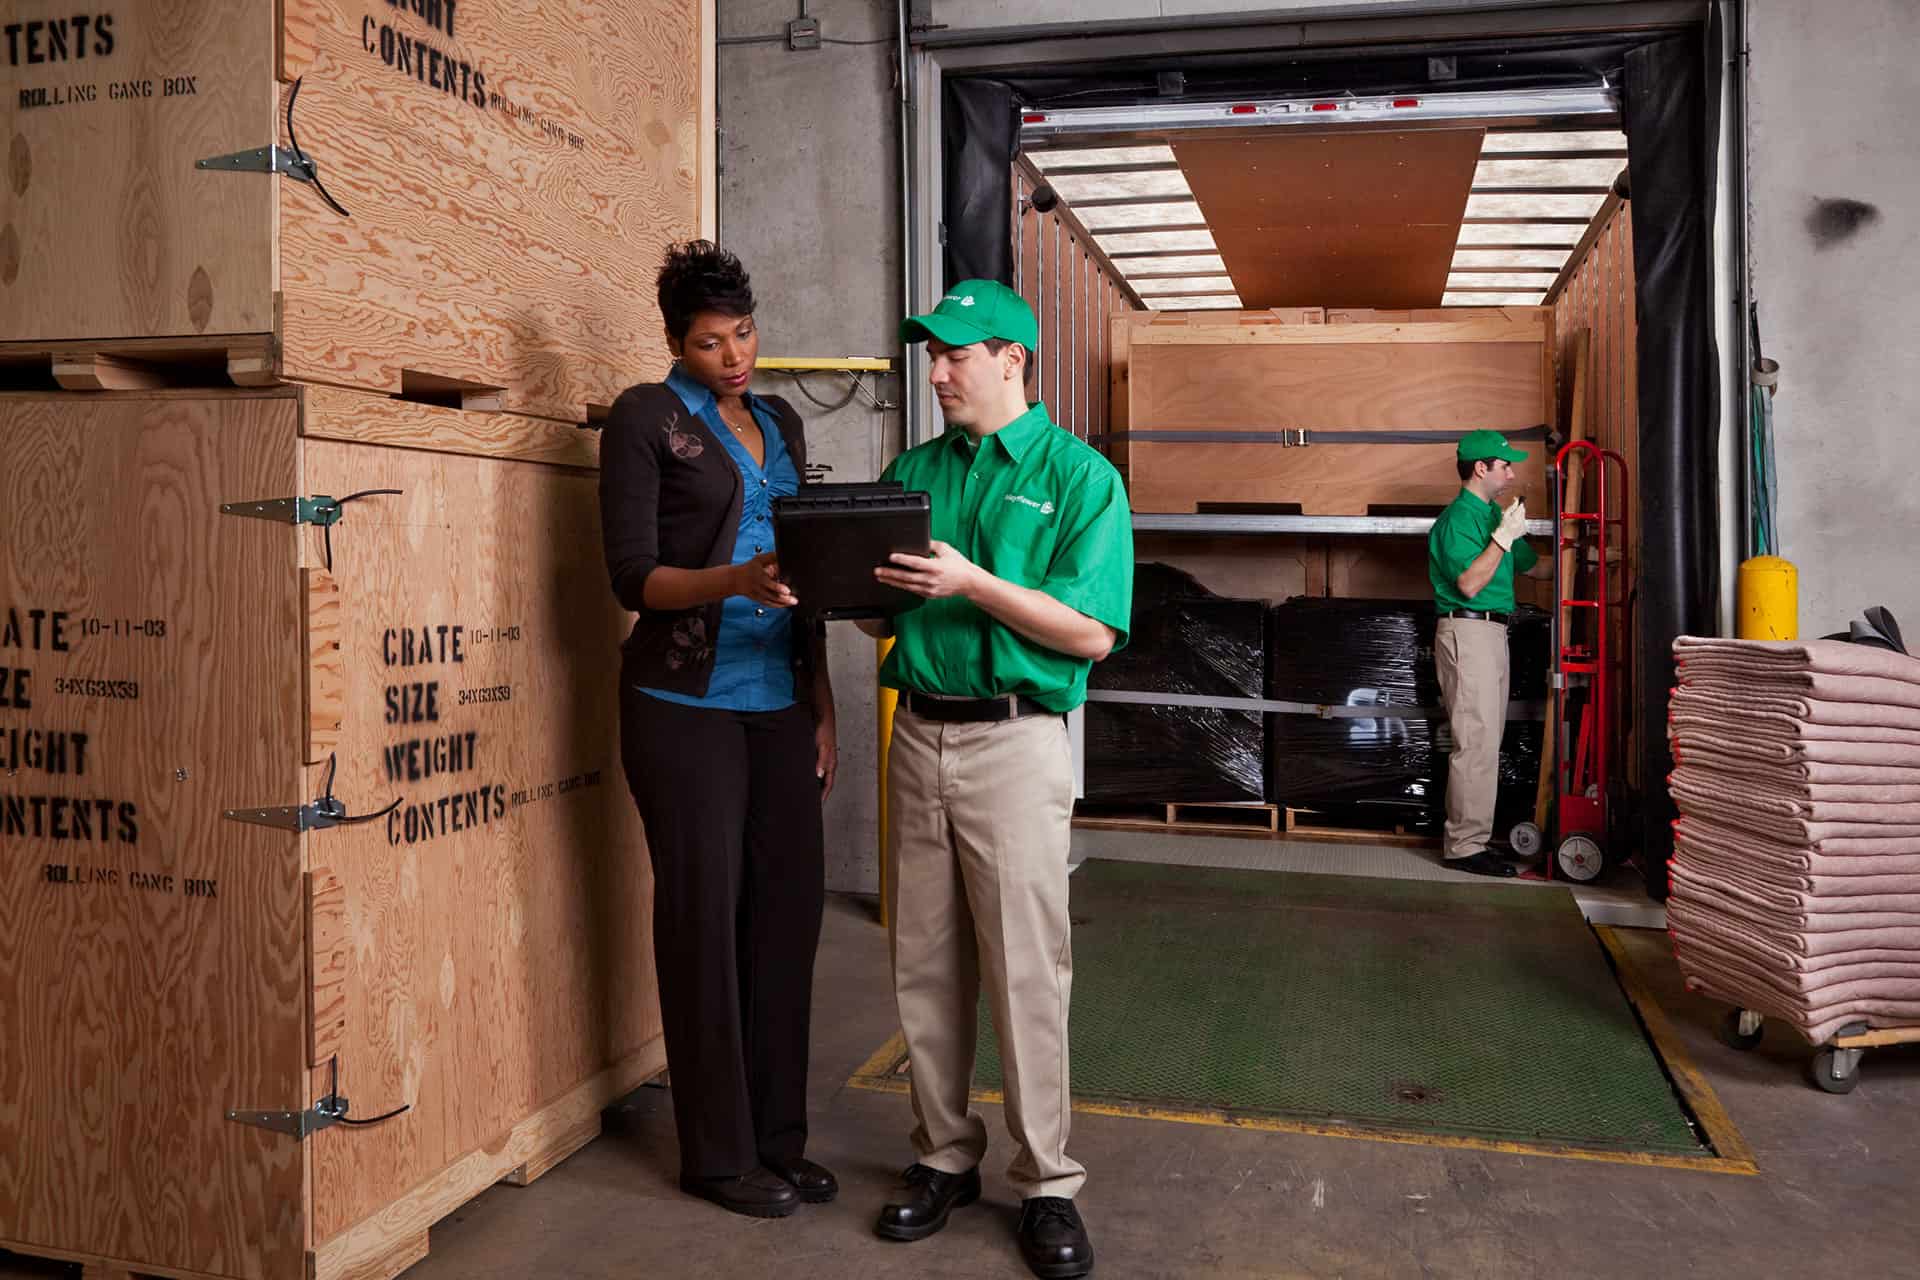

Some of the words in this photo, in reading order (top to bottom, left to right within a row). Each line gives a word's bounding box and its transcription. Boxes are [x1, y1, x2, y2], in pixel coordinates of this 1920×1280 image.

[4, 13, 114, 66] TENTS
[19, 84, 97, 109] ROLLING
[108, 79, 152, 101] GANG
[163, 76, 197, 97] BOX
[362, 15, 486, 109] CONTENTS
[490, 92, 535, 128] ROLLING
[3, 608, 69, 652] ATE
[81, 618, 167, 638] 10-11-03
[383, 625, 464, 667] CRATE
[471, 626, 521, 646] 10-11-03
[55, 677, 139, 700] 34X63X59
[384, 681, 440, 725] SIZE
[458, 685, 512, 706] 34X63X59
[0, 728, 88, 775] IGHT
[384, 731, 477, 783] WEIGHT
[0, 796, 138, 845] NTENTS
[387, 783, 506, 847] CONTENTS
[511, 783, 553, 809] ROLLING
[41, 863, 119, 887] ROLLING
[129, 871, 174, 894] GANG
[184, 879, 218, 899] BOX
